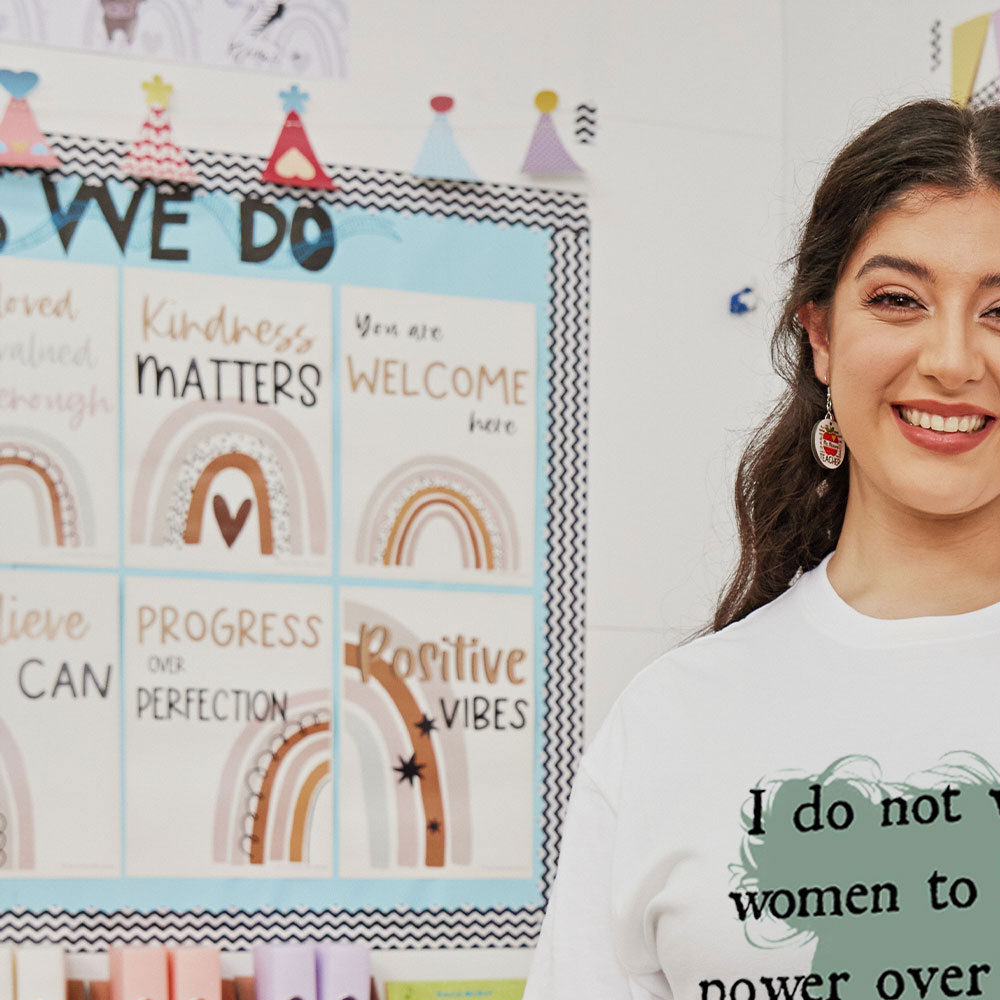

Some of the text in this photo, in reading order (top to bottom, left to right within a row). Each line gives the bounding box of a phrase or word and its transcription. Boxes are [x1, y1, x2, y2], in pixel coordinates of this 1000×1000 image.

[41, 174, 194, 262] WE
[239, 194, 336, 272] DO
[140, 295, 316, 353] Kindness
[355, 313, 444, 342] You are
[347, 354, 530, 406] WELCOME
[468, 410, 519, 436] here
[137, 604, 324, 649] PROGRESS
[150, 654, 186, 675] OVER
[359, 623, 529, 685] Positive
[18, 657, 113, 700] CAN
[136, 686, 289, 722] PERFECTION
[439, 695, 529, 731] VIBES
[747, 788, 767, 836] I
[792, 783, 855, 834] do
[880, 784, 963, 828] not
[728, 876, 900, 922] women
[927, 869, 978, 910] to
